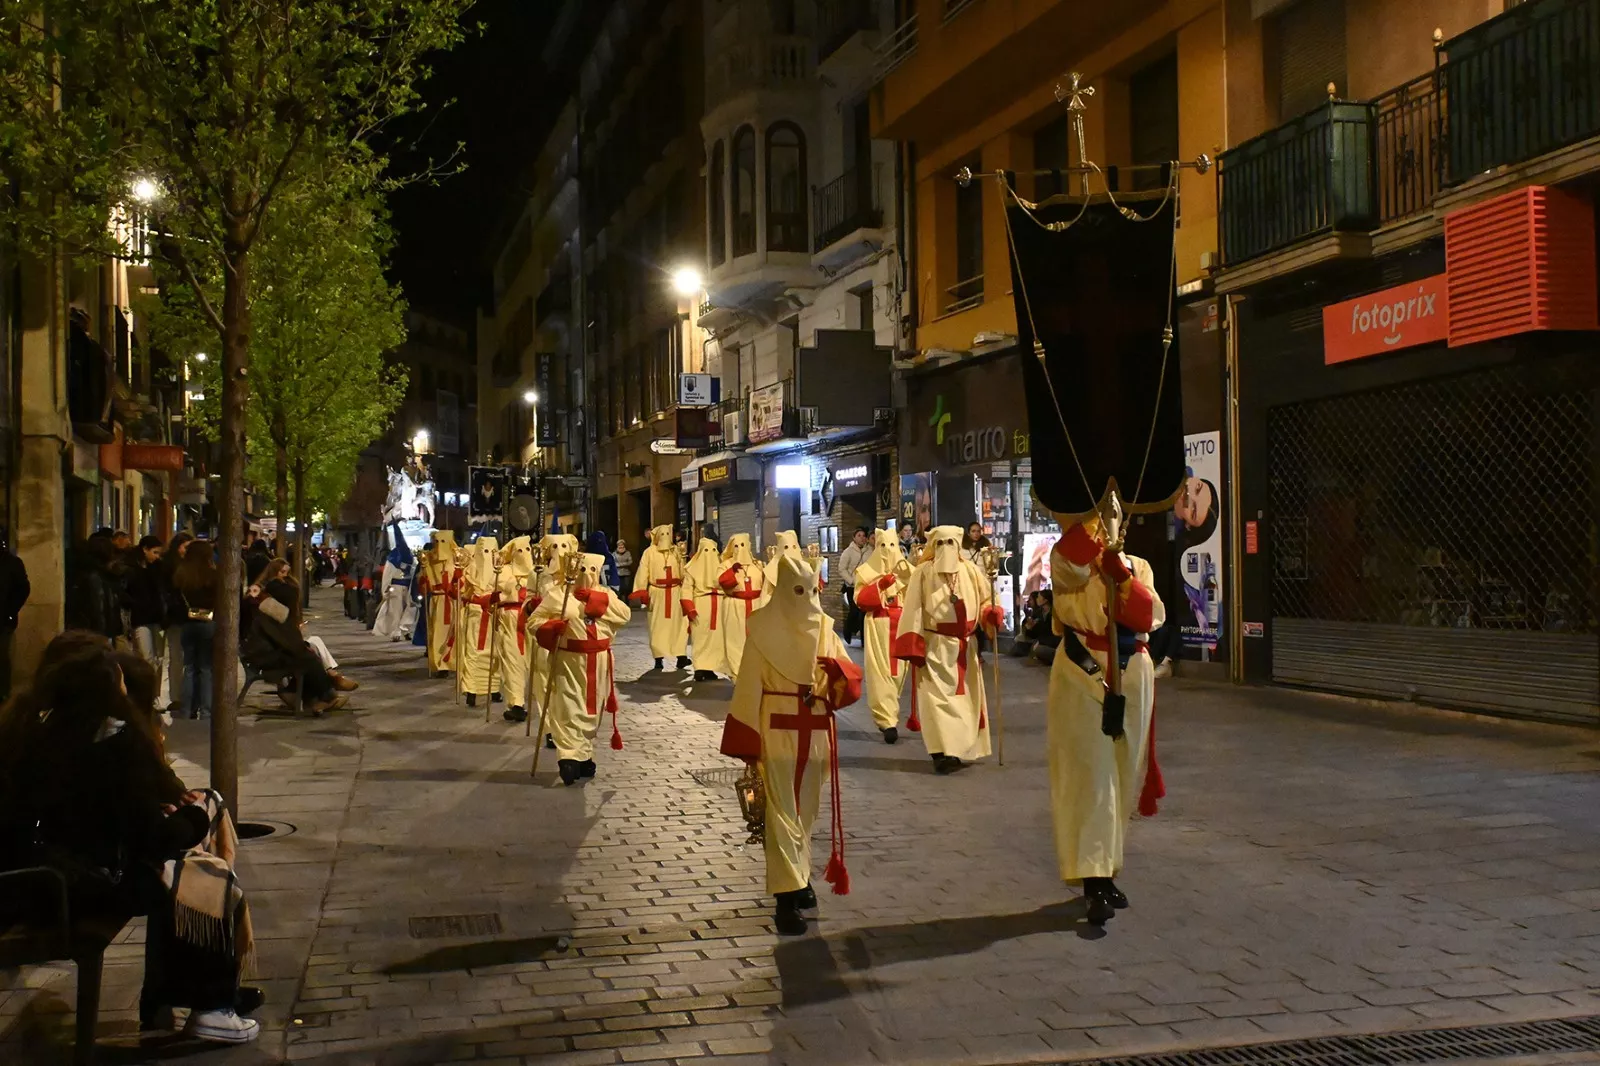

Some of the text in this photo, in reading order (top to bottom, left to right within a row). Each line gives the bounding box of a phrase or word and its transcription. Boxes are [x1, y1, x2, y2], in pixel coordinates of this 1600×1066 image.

[1351, 285, 1437, 334] fotoprix
[946, 426, 1005, 464] marro
[1184, 440, 1215, 457] HYTO
[903, 501, 914, 518] 20
